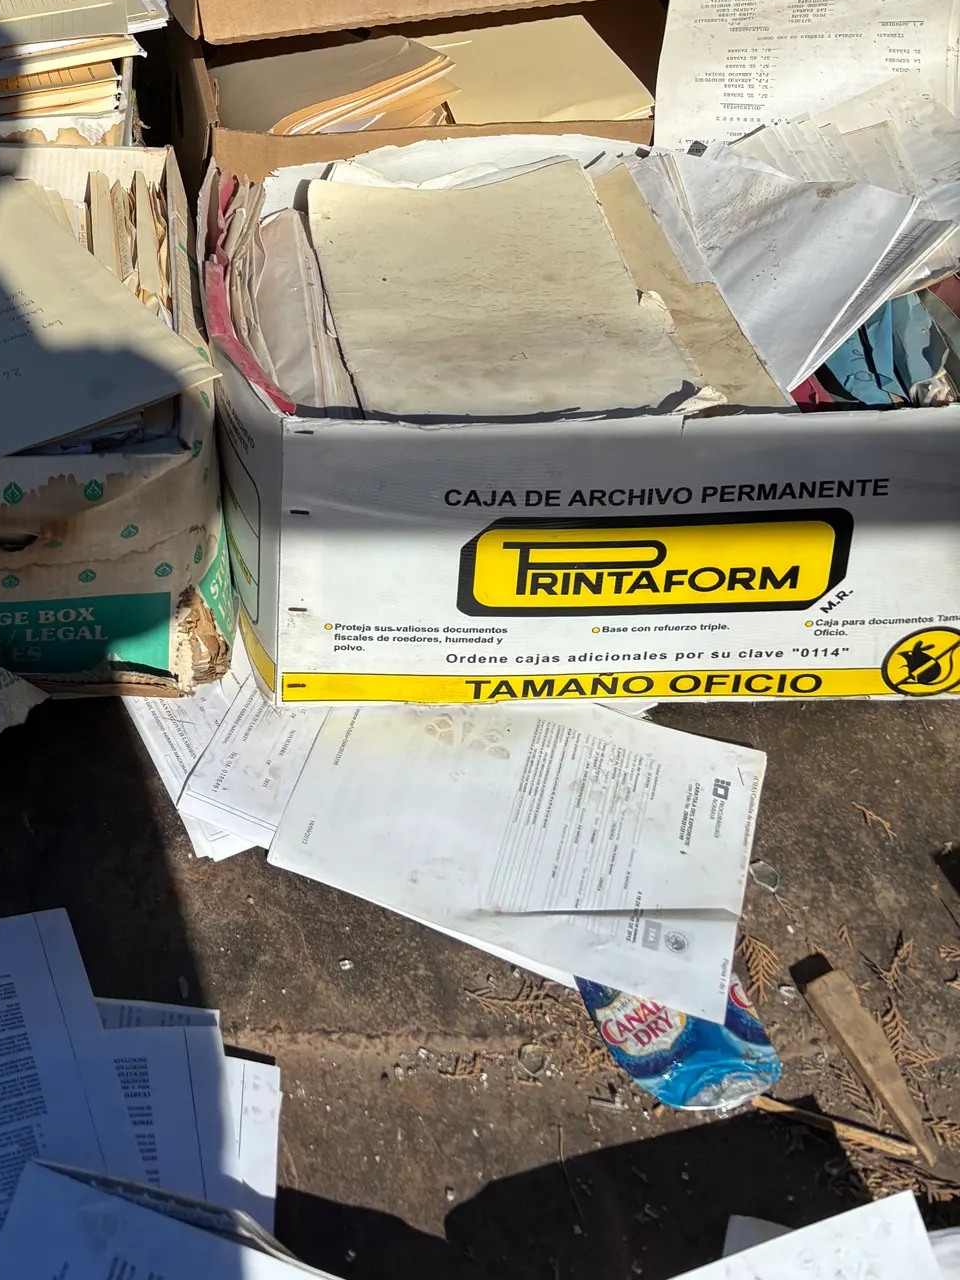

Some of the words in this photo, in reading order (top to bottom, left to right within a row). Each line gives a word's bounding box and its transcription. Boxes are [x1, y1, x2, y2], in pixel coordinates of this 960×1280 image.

[444, 489, 517, 507] CAJA
[525, 489, 562, 507] DE
[568, 486, 693, 507] ARCHIVO
[701, 478, 889, 504] PERMANENTE
[502, 539, 800, 596] PRINTAFORM
[819, 588, 854, 614] M.R.
[38, 607, 96, 624] BOX
[815, 618, 839, 628] Caja
[841, 618, 865, 628] para
[868, 615, 934, 626] documentos
[937, 614, 960, 623] Tama
[25, 625, 109, 642] LEGAL
[334, 623, 372, 633] Proteja
[396, 625, 440, 633] valiosos
[443, 626, 508, 634] documentos
[602, 625, 629, 633] Base
[653, 623, 697, 632] refuerzo
[700, 623, 730, 632] triple.
[813, 628, 848, 637] Oficio.
[334, 633, 374, 643] fiscales
[377, 634, 390, 643] de
[392, 634, 442, 644] roedores,
[445, 635, 494, 644] humedad
[496, 636, 503, 645] y
[333, 643, 365, 653] polvo.
[445, 653, 508, 664] Ordene
[515, 653, 560, 665] cajas
[568, 649, 668, 663] adicionales
[675, 649, 705, 662] por
[711, 649, 731, 659] su
[738, 648, 784, 659] clave
[792, 647, 850, 658] "0114"
[465, 673, 655, 700] TAMAÑO
[669, 673, 823, 694] OFICIO
[633, 1010, 674, 1047] DRY
